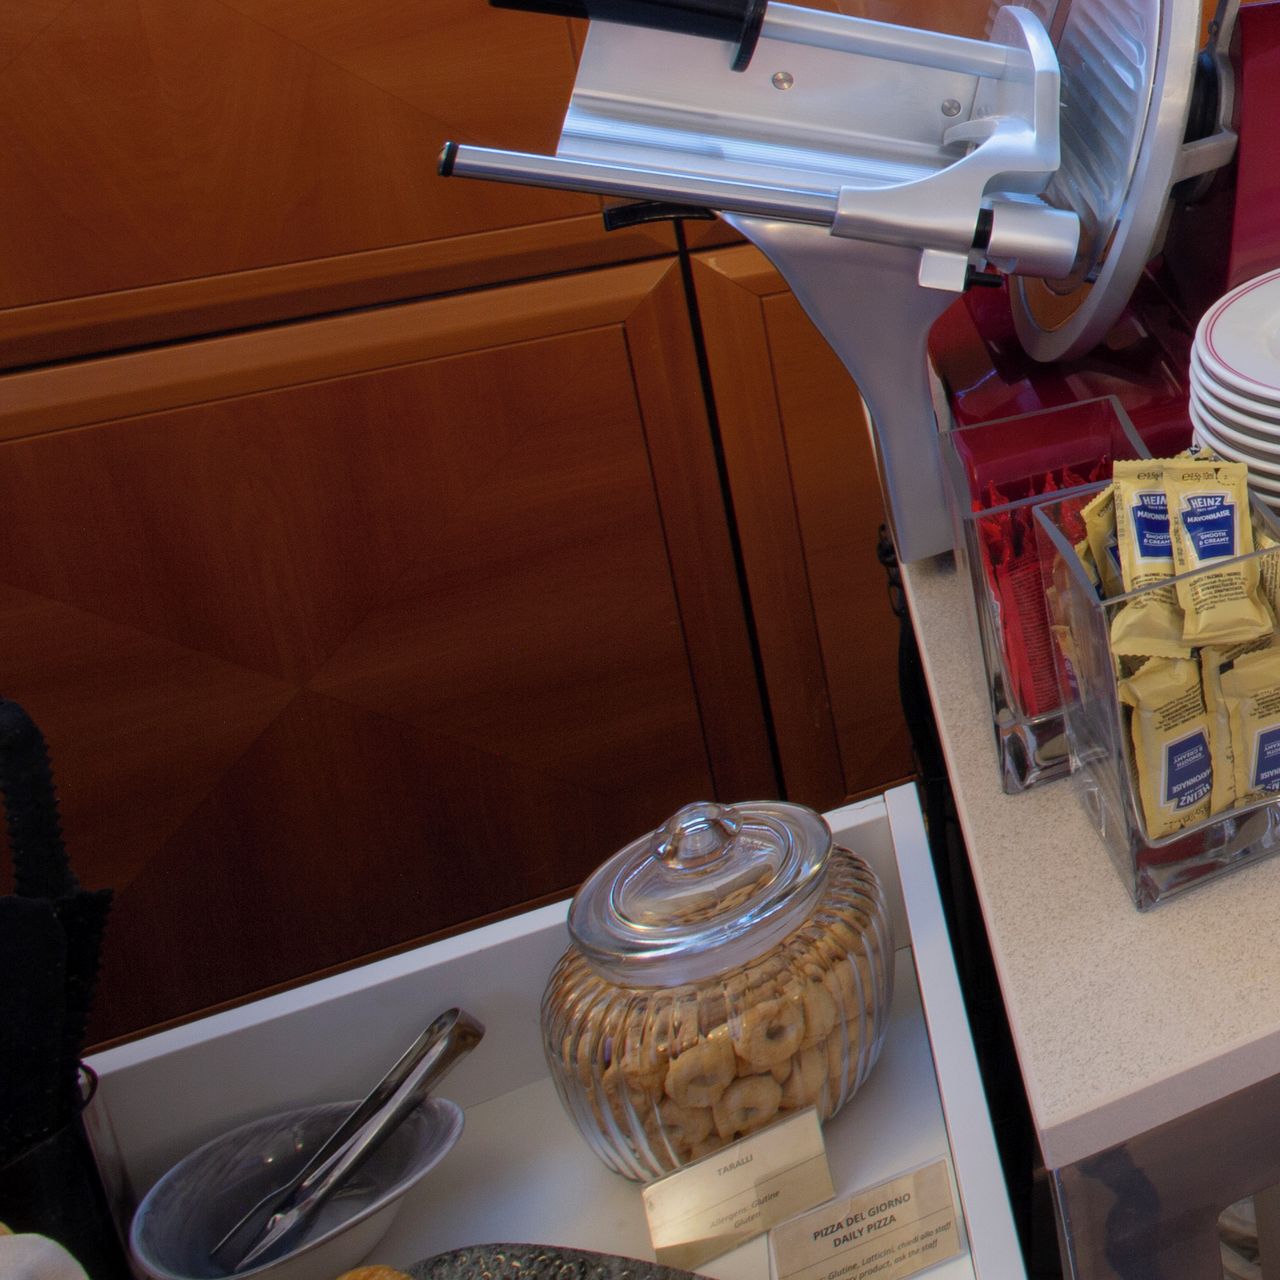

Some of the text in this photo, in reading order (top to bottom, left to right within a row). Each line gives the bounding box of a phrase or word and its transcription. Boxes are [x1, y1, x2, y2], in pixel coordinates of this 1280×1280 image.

[1142, 495, 1166, 505] HEIN
[1190, 497, 1222, 508] HEINZ
[1187, 509, 1231, 523] MAYONNAISE
[1200, 532, 1227, 540] SMOOTH
[1203, 536, 1229, 545] CREAMY
[1179, 784, 1211, 807] HEINZ
[716, 1154, 754, 1176] TARALLI
[751, 1189, 781, 1209] Glutine
[734, 1210, 762, 1229] Gluten
[812, 1193, 911, 1240] PIZZA DEL GIORNO
[833, 1214, 897, 1248] DAILY PIZZA
[934, 1221, 952, 1237] staff
[894, 1254, 907, 1265] ask
[908, 1246, 921, 1258] the
[921, 1238, 938, 1254] staff
